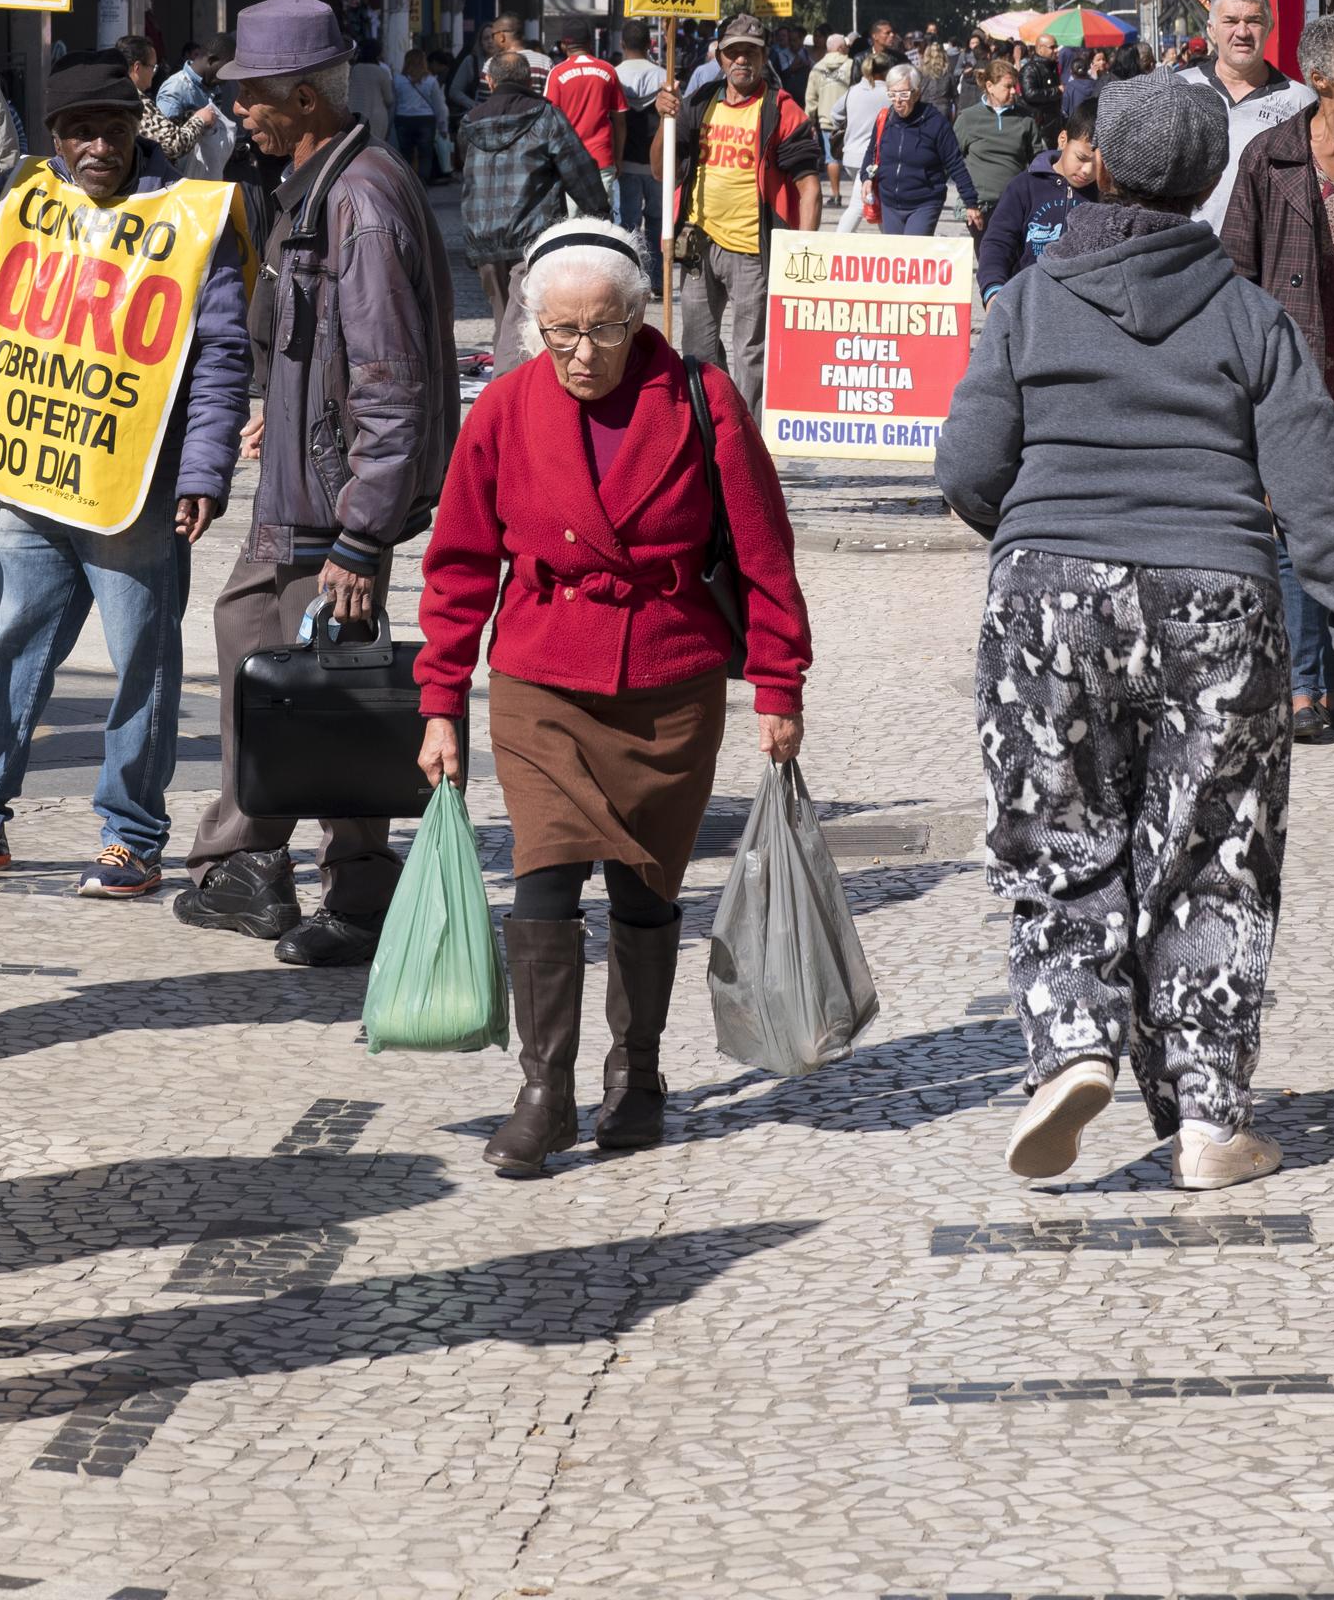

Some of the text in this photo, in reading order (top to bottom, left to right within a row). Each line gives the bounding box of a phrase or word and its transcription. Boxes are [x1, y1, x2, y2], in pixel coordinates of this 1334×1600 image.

[18, 187, 176, 262] COMPRO
[829, 255, 953, 286] ADVOGADO
[781, 298, 959, 337] TRABALHISTA
[835, 335, 900, 362] CÍVEL
[820, 363, 914, 390] FAMÍLIA
[837, 389, 894, 413] INSS
[7, 388, 117, 455] OFERTA
[778, 418, 942, 447] CONSULTA GRÁTI
[35, 445, 81, 494] DIA
